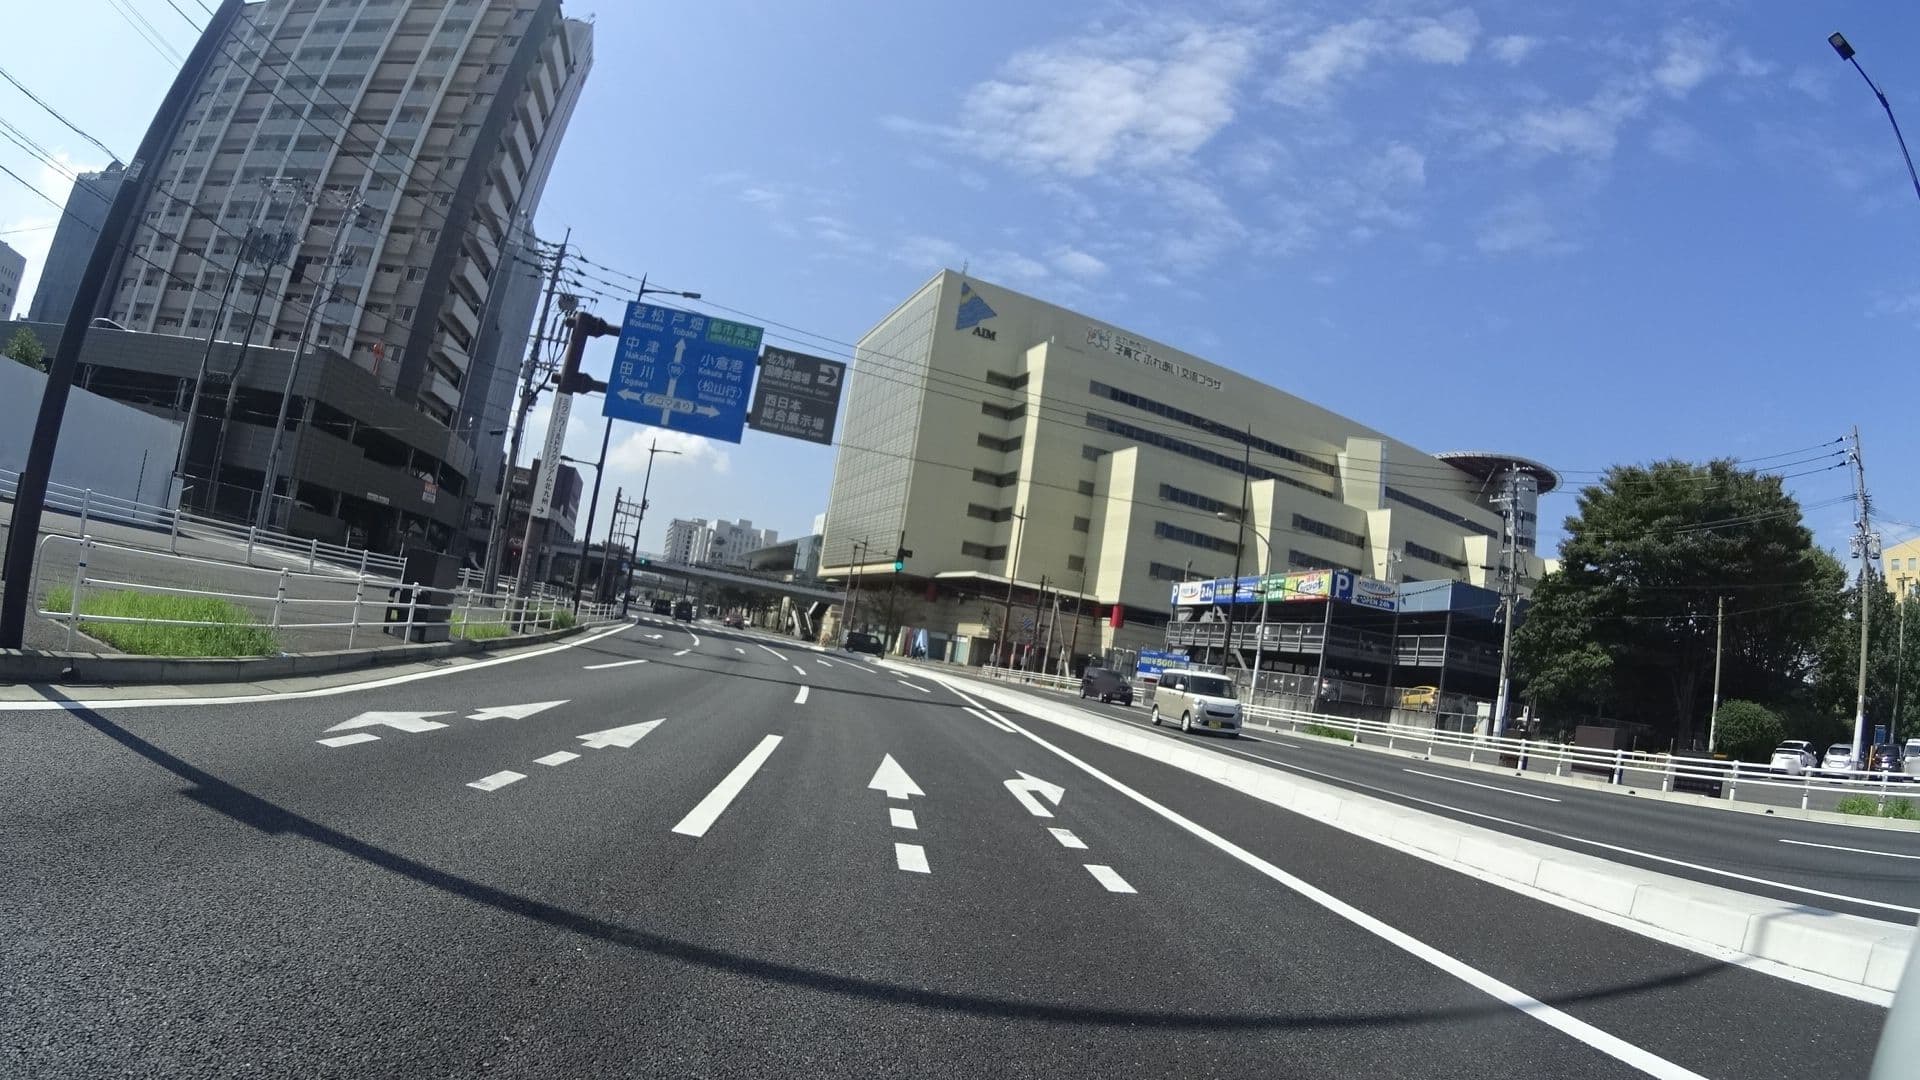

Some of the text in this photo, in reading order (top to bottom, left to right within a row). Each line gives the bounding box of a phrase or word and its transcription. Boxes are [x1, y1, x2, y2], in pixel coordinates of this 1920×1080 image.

[632, 306, 704, 331] 若松 戸畑
[629, 319, 698, 338] Wakamatsu Tobata
[972, 326, 997, 341] AIM
[627, 337, 659, 354] 中津
[625, 350, 655, 364] Nakatsu
[701, 354, 744, 374] 小倉港
[768, 353, 796, 369] 北九州
[620, 361, 655, 380] 田川
[621, 376, 649, 389] Tagawa
[765, 394, 802, 411] 西日本
[762, 407, 824, 430] 総合展示場
[1172, 584, 1179, 602] P
[1335, 574, 1350, 598] P
